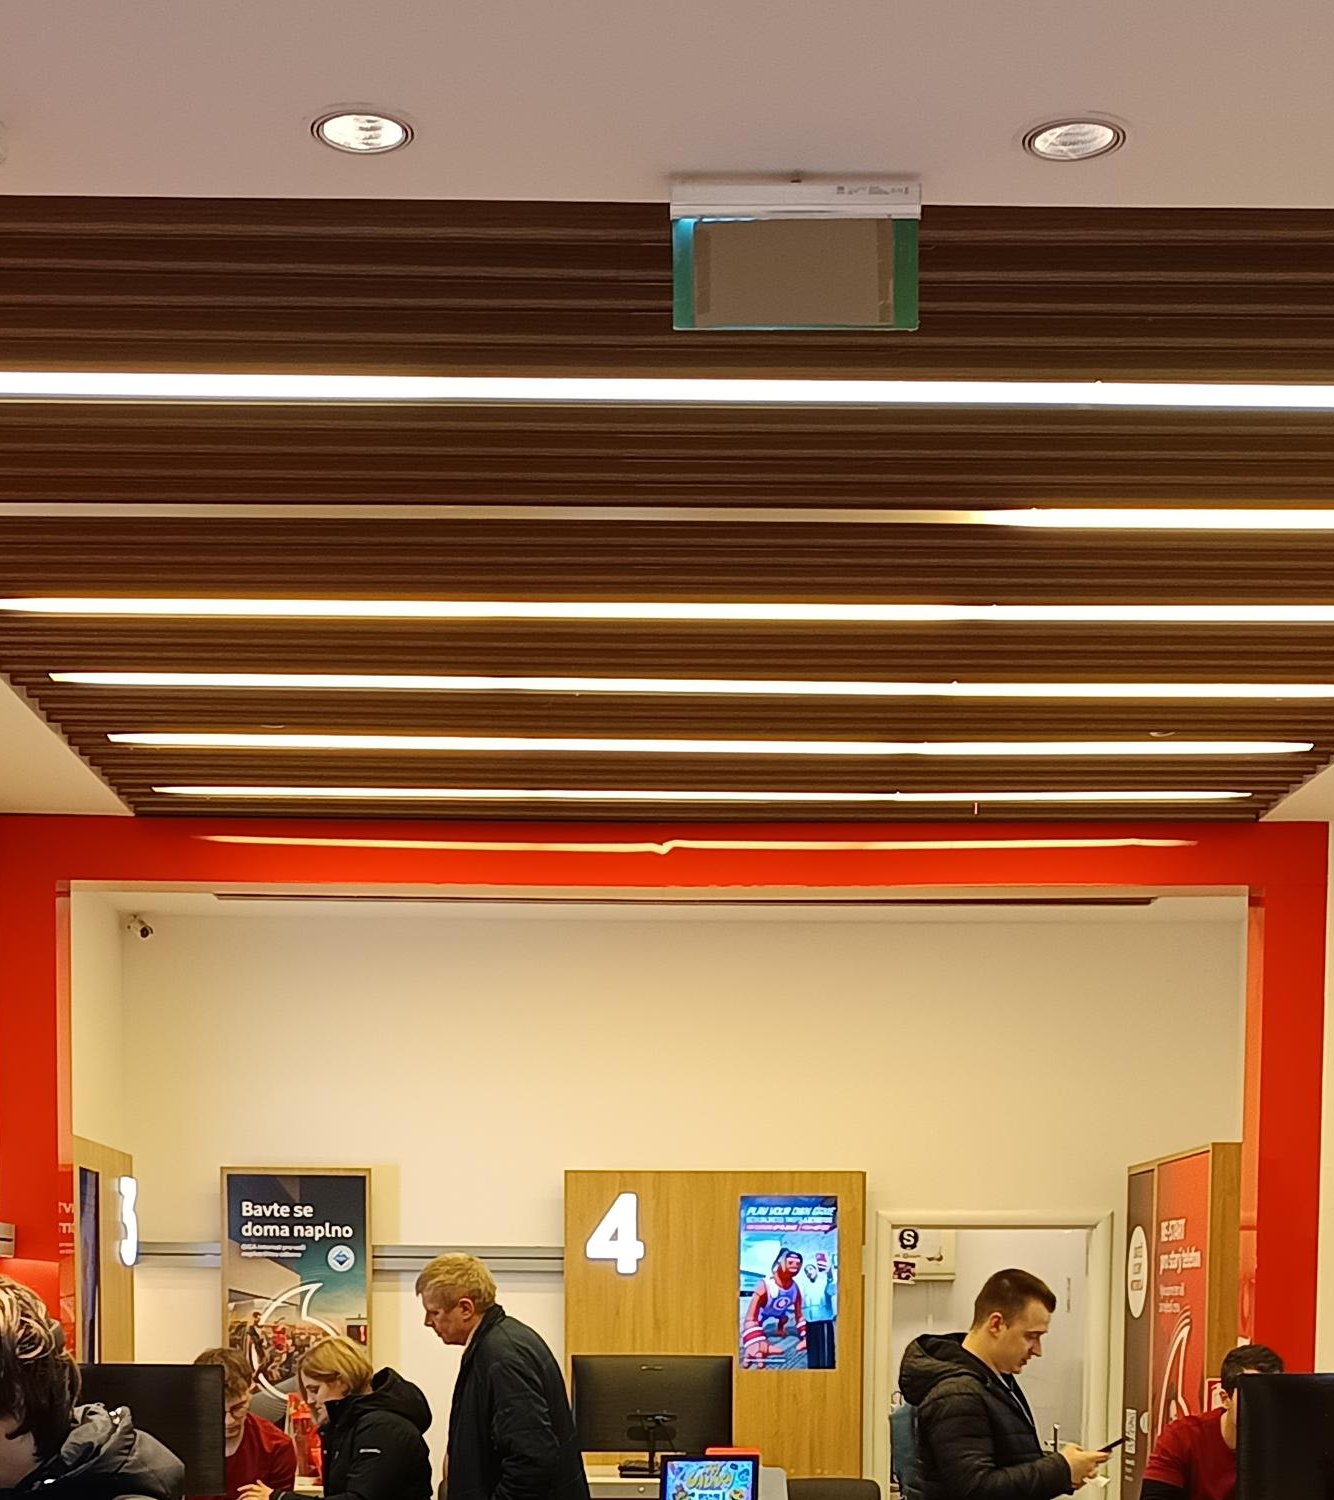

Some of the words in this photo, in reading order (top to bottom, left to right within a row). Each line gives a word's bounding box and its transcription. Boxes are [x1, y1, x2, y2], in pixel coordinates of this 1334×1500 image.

[241, 1201, 291, 1217] Bavte
[293, 1205, 314, 1217] se
[241, 1221, 290, 1237] doma
[293, 1222, 354, 1241] naplno
[585, 1192, 645, 1274] 4
